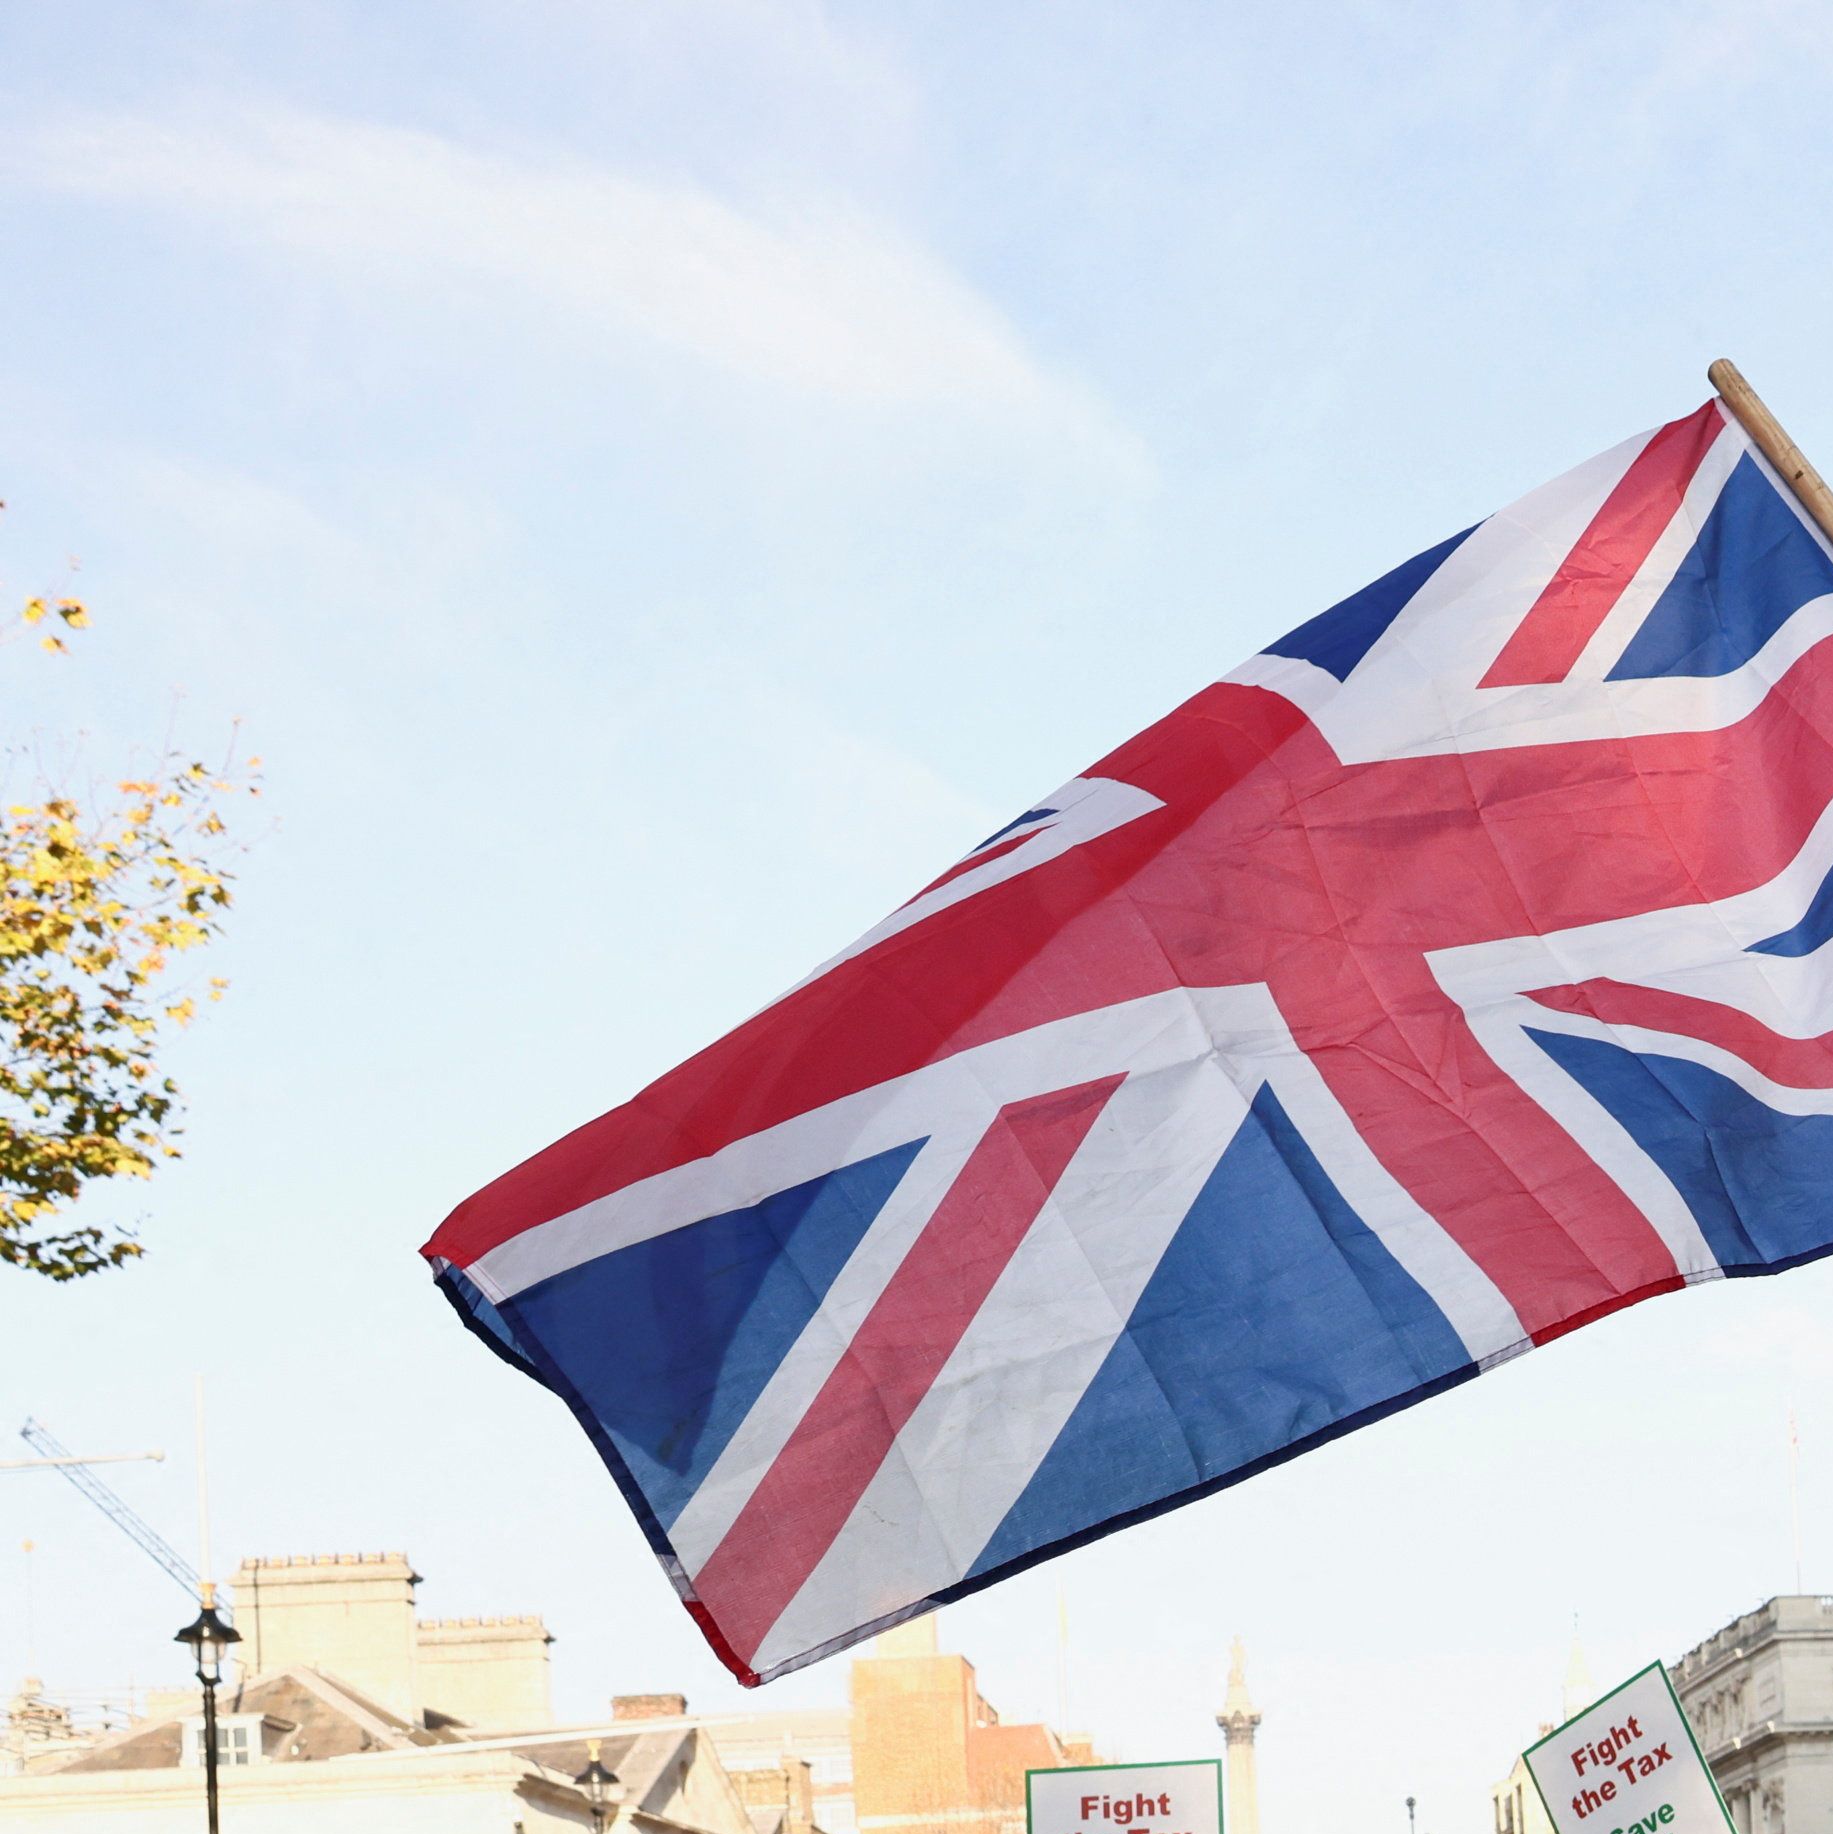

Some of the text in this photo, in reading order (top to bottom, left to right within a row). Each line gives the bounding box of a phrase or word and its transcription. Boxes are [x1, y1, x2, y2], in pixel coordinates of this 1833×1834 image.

[1571, 1715, 1643, 1777] Fight
[1080, 1793, 1171, 1825] Fight
[1571, 1742, 1673, 1819] the Tax
